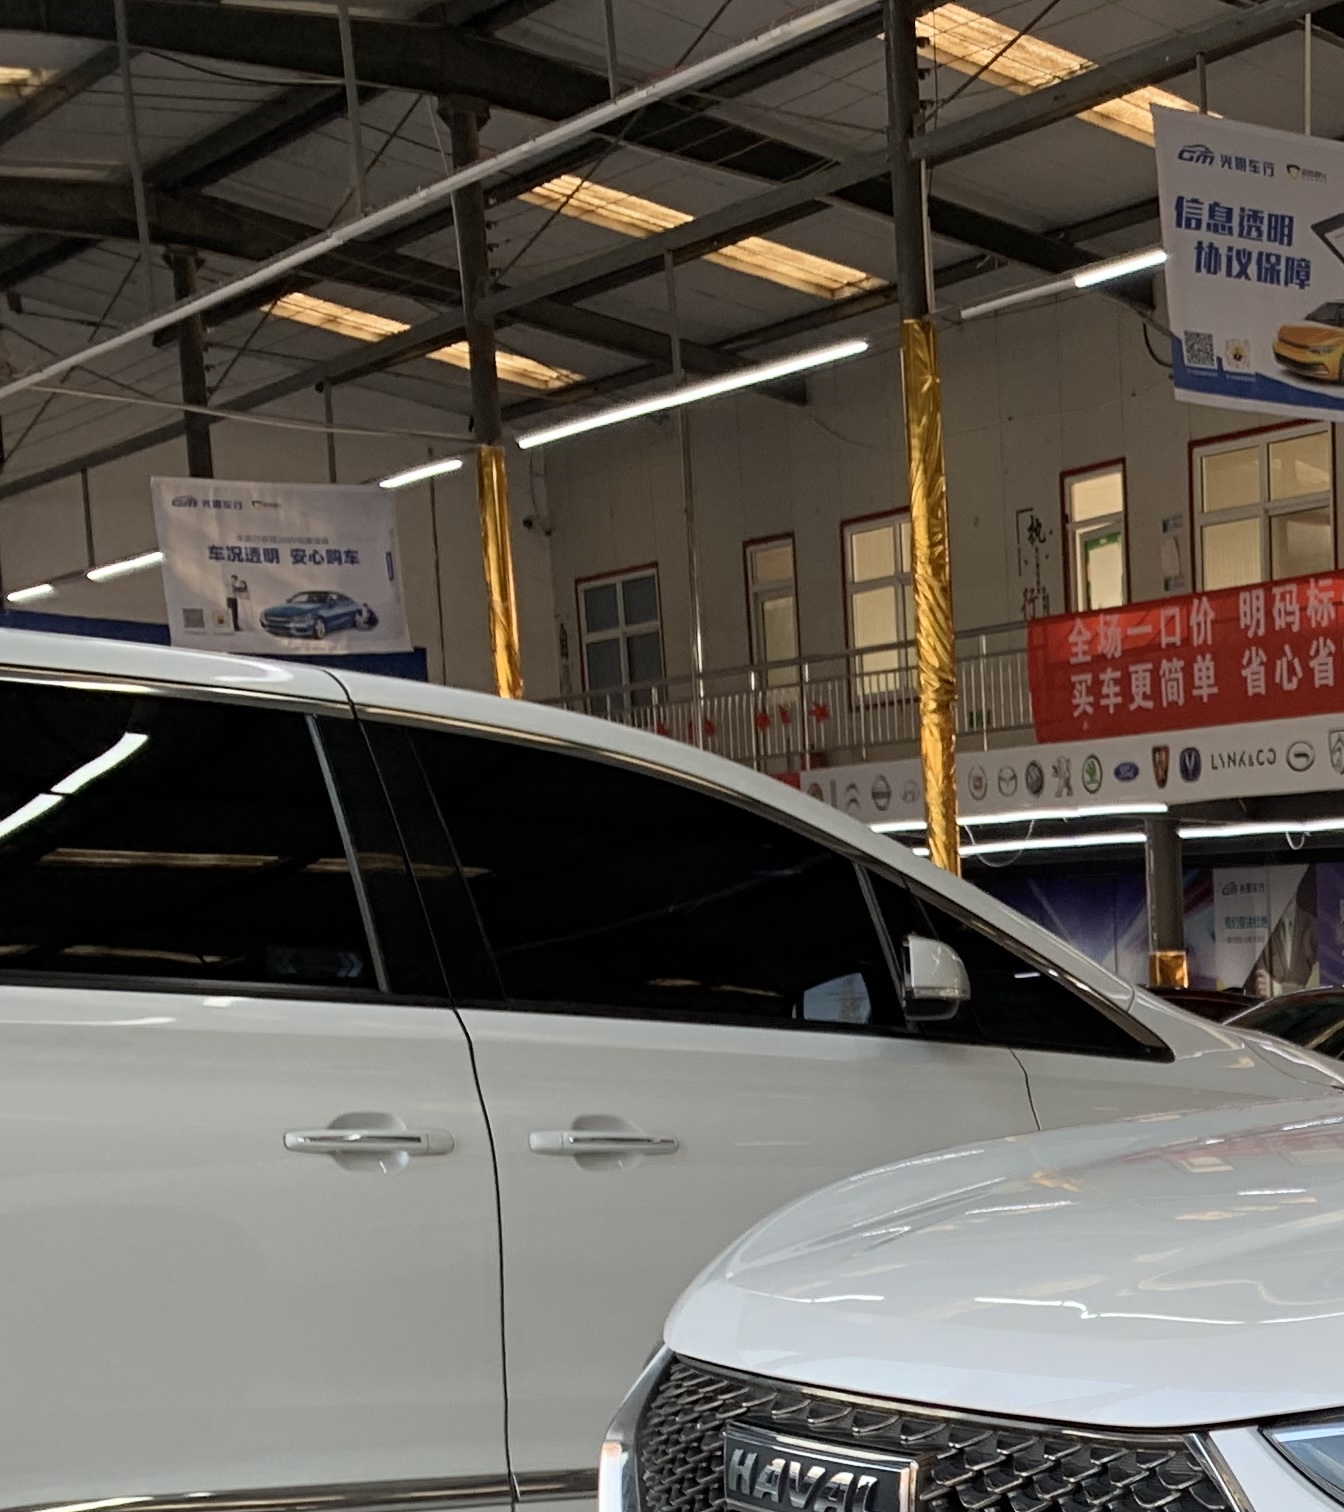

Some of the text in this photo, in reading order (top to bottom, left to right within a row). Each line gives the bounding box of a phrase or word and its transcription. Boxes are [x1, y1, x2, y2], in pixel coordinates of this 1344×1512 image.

[1220, 153, 1275, 177] 光明车行
[1174, 195, 1294, 248] 信息透明
[1194, 241, 1312, 290] 协议保障
[207, 545, 360, 566] 车况透明 安心购车
[1067, 596, 1217, 666] 全场一口价
[1071, 653, 1219, 718] 买车更简单
